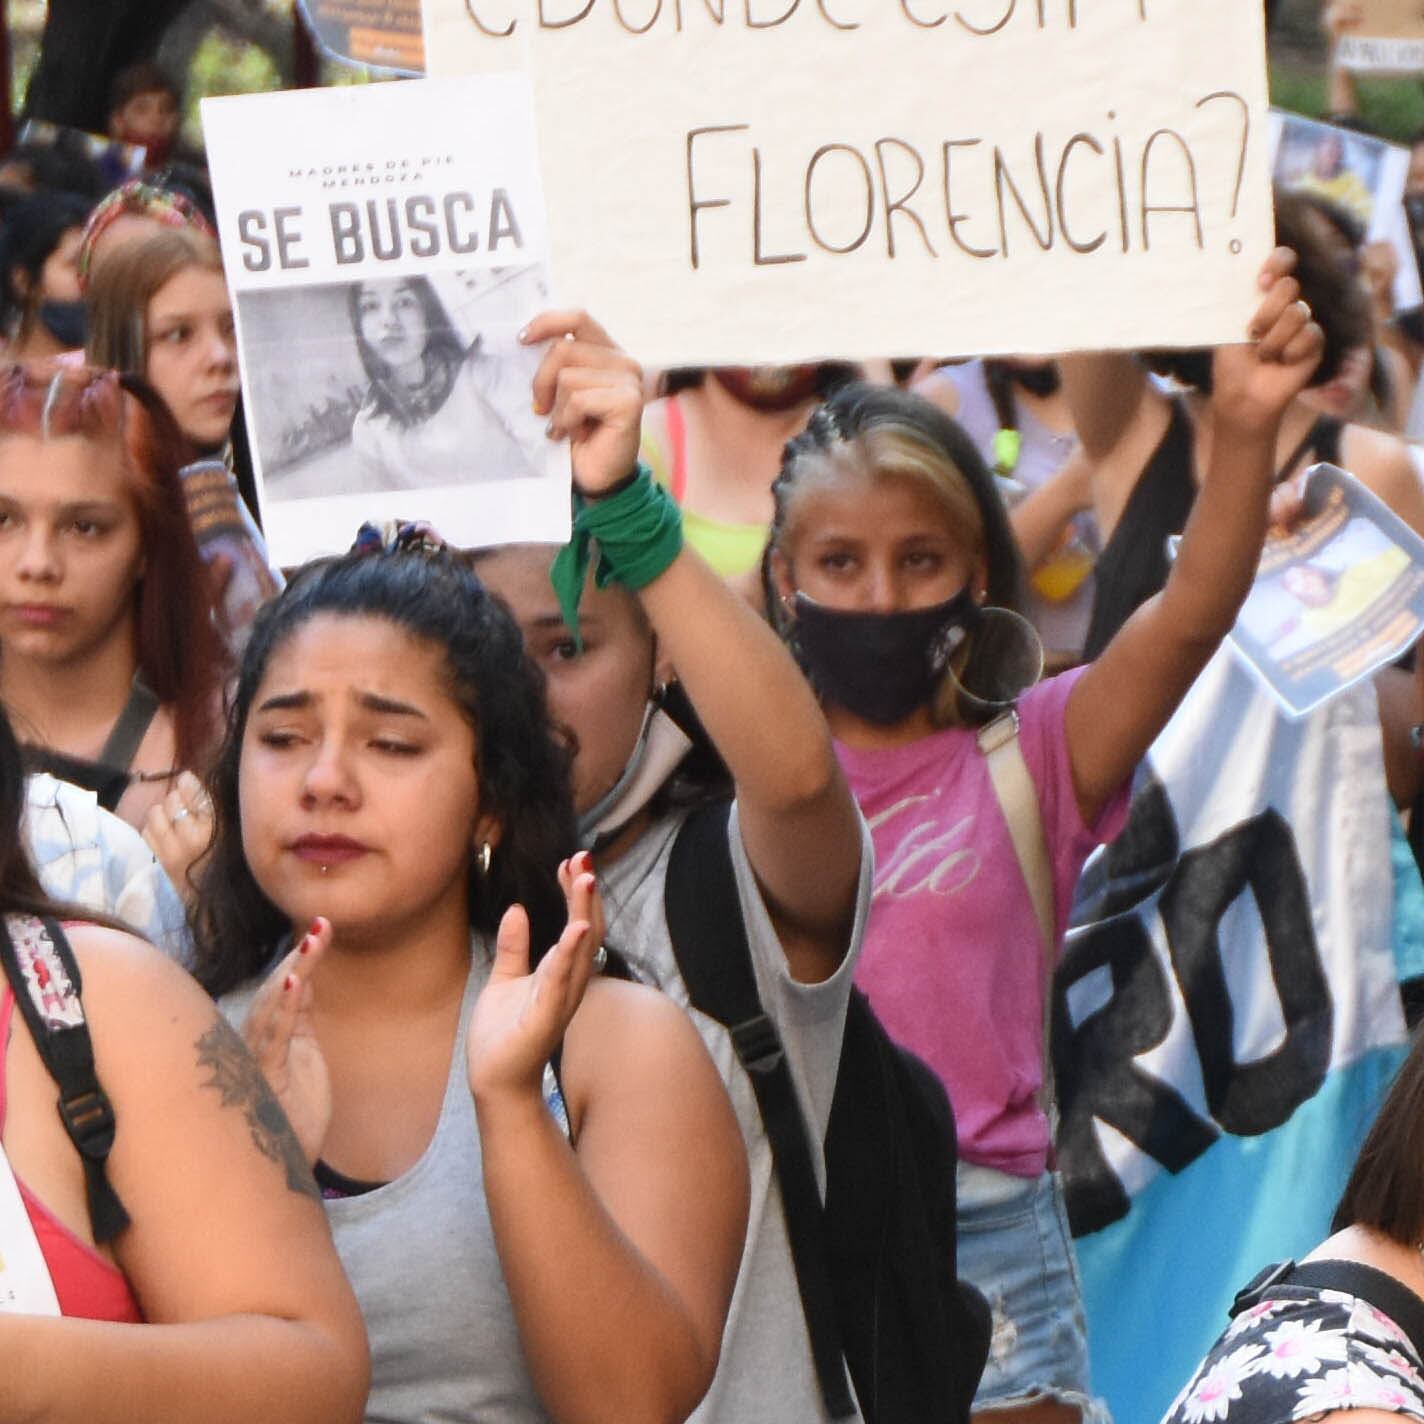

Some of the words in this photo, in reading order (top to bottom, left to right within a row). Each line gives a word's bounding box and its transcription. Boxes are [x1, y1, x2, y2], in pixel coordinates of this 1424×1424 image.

[386, 159, 410, 170] DE
[686, 90, 1249, 270] FLORENCIA?
[237, 206, 310, 272] SE
[328, 187, 524, 266] BUSCA
